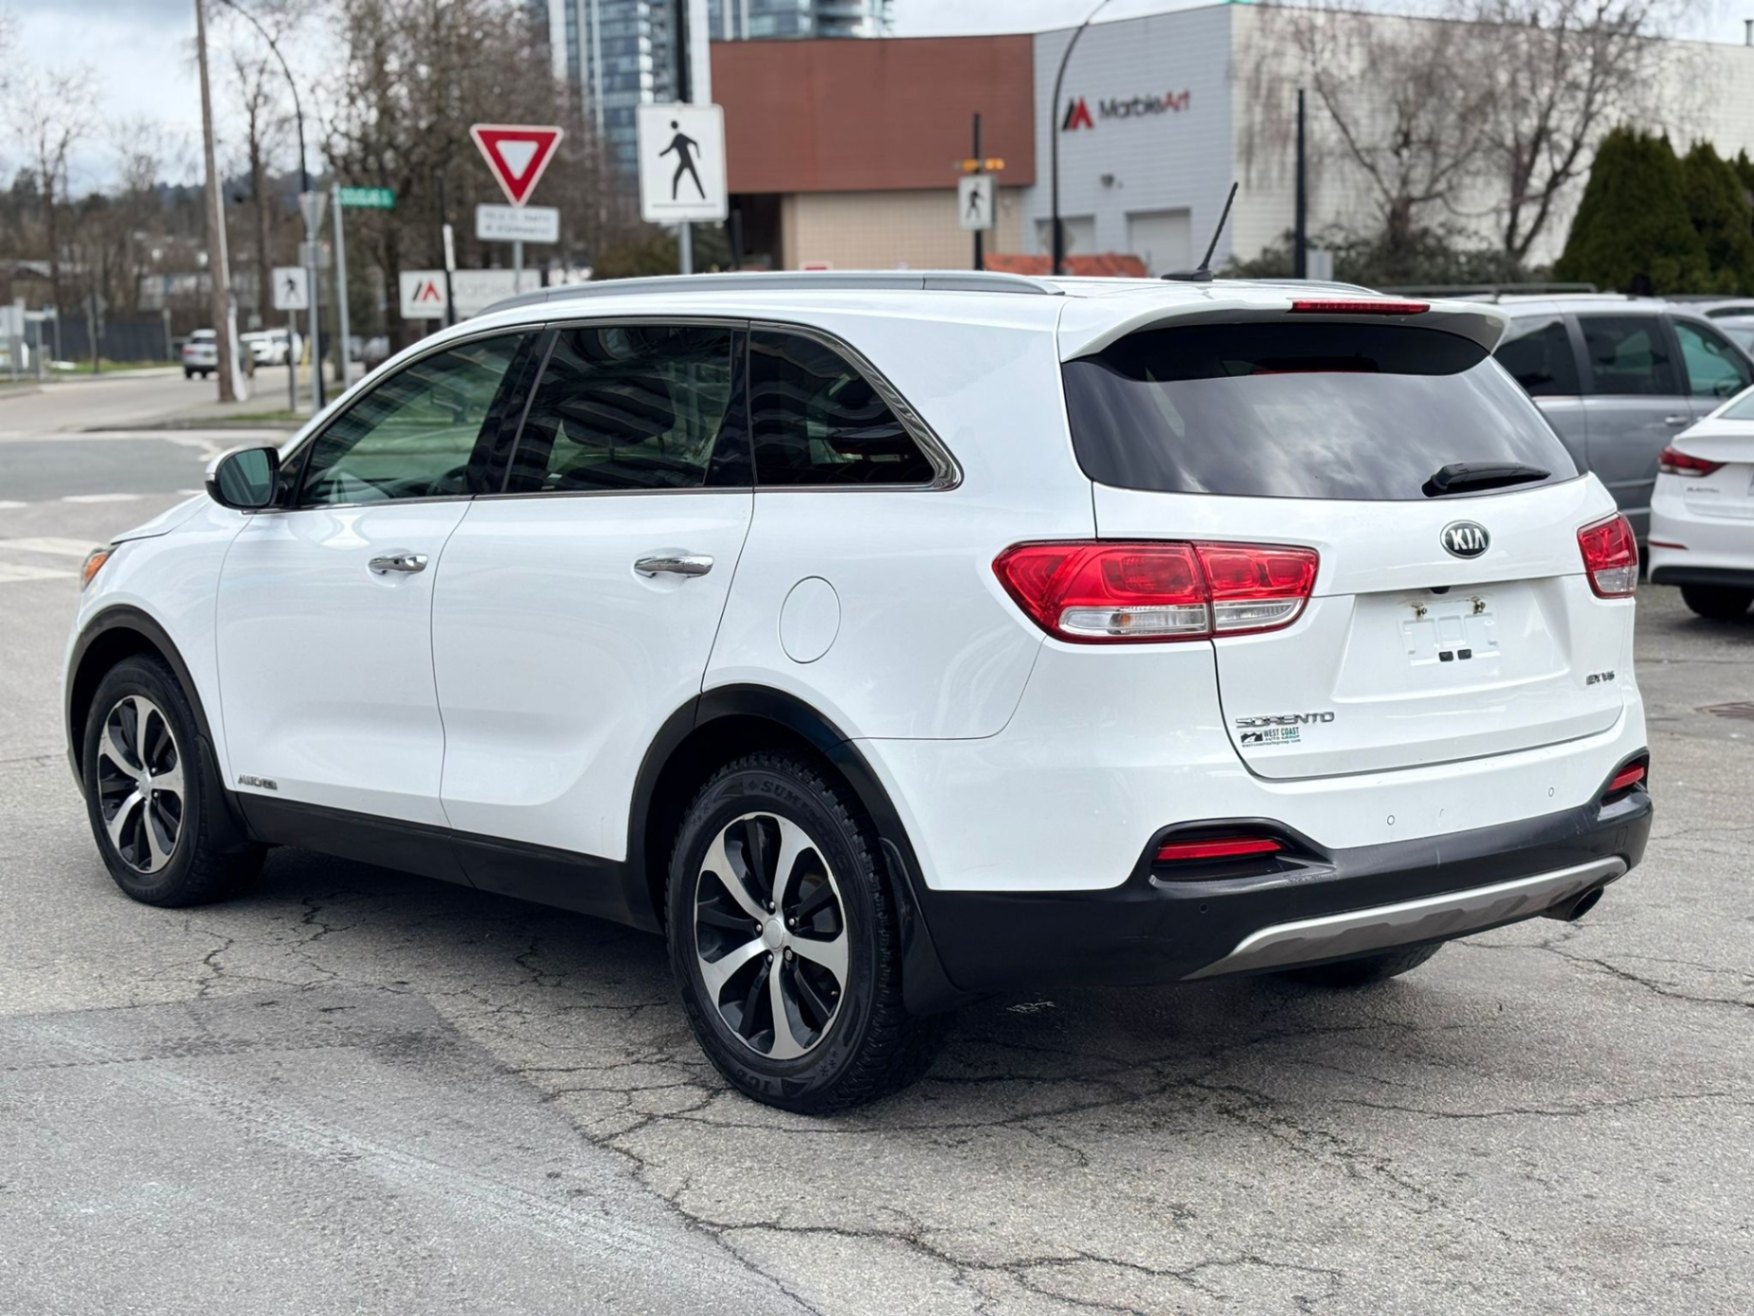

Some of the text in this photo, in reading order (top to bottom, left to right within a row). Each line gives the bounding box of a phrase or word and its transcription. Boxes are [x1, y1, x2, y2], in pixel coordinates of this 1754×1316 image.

[1450, 528, 1487, 550] KIA
[1236, 711, 1335, 728] SORENTO
[1263, 726, 1299, 738] WEST COAST
